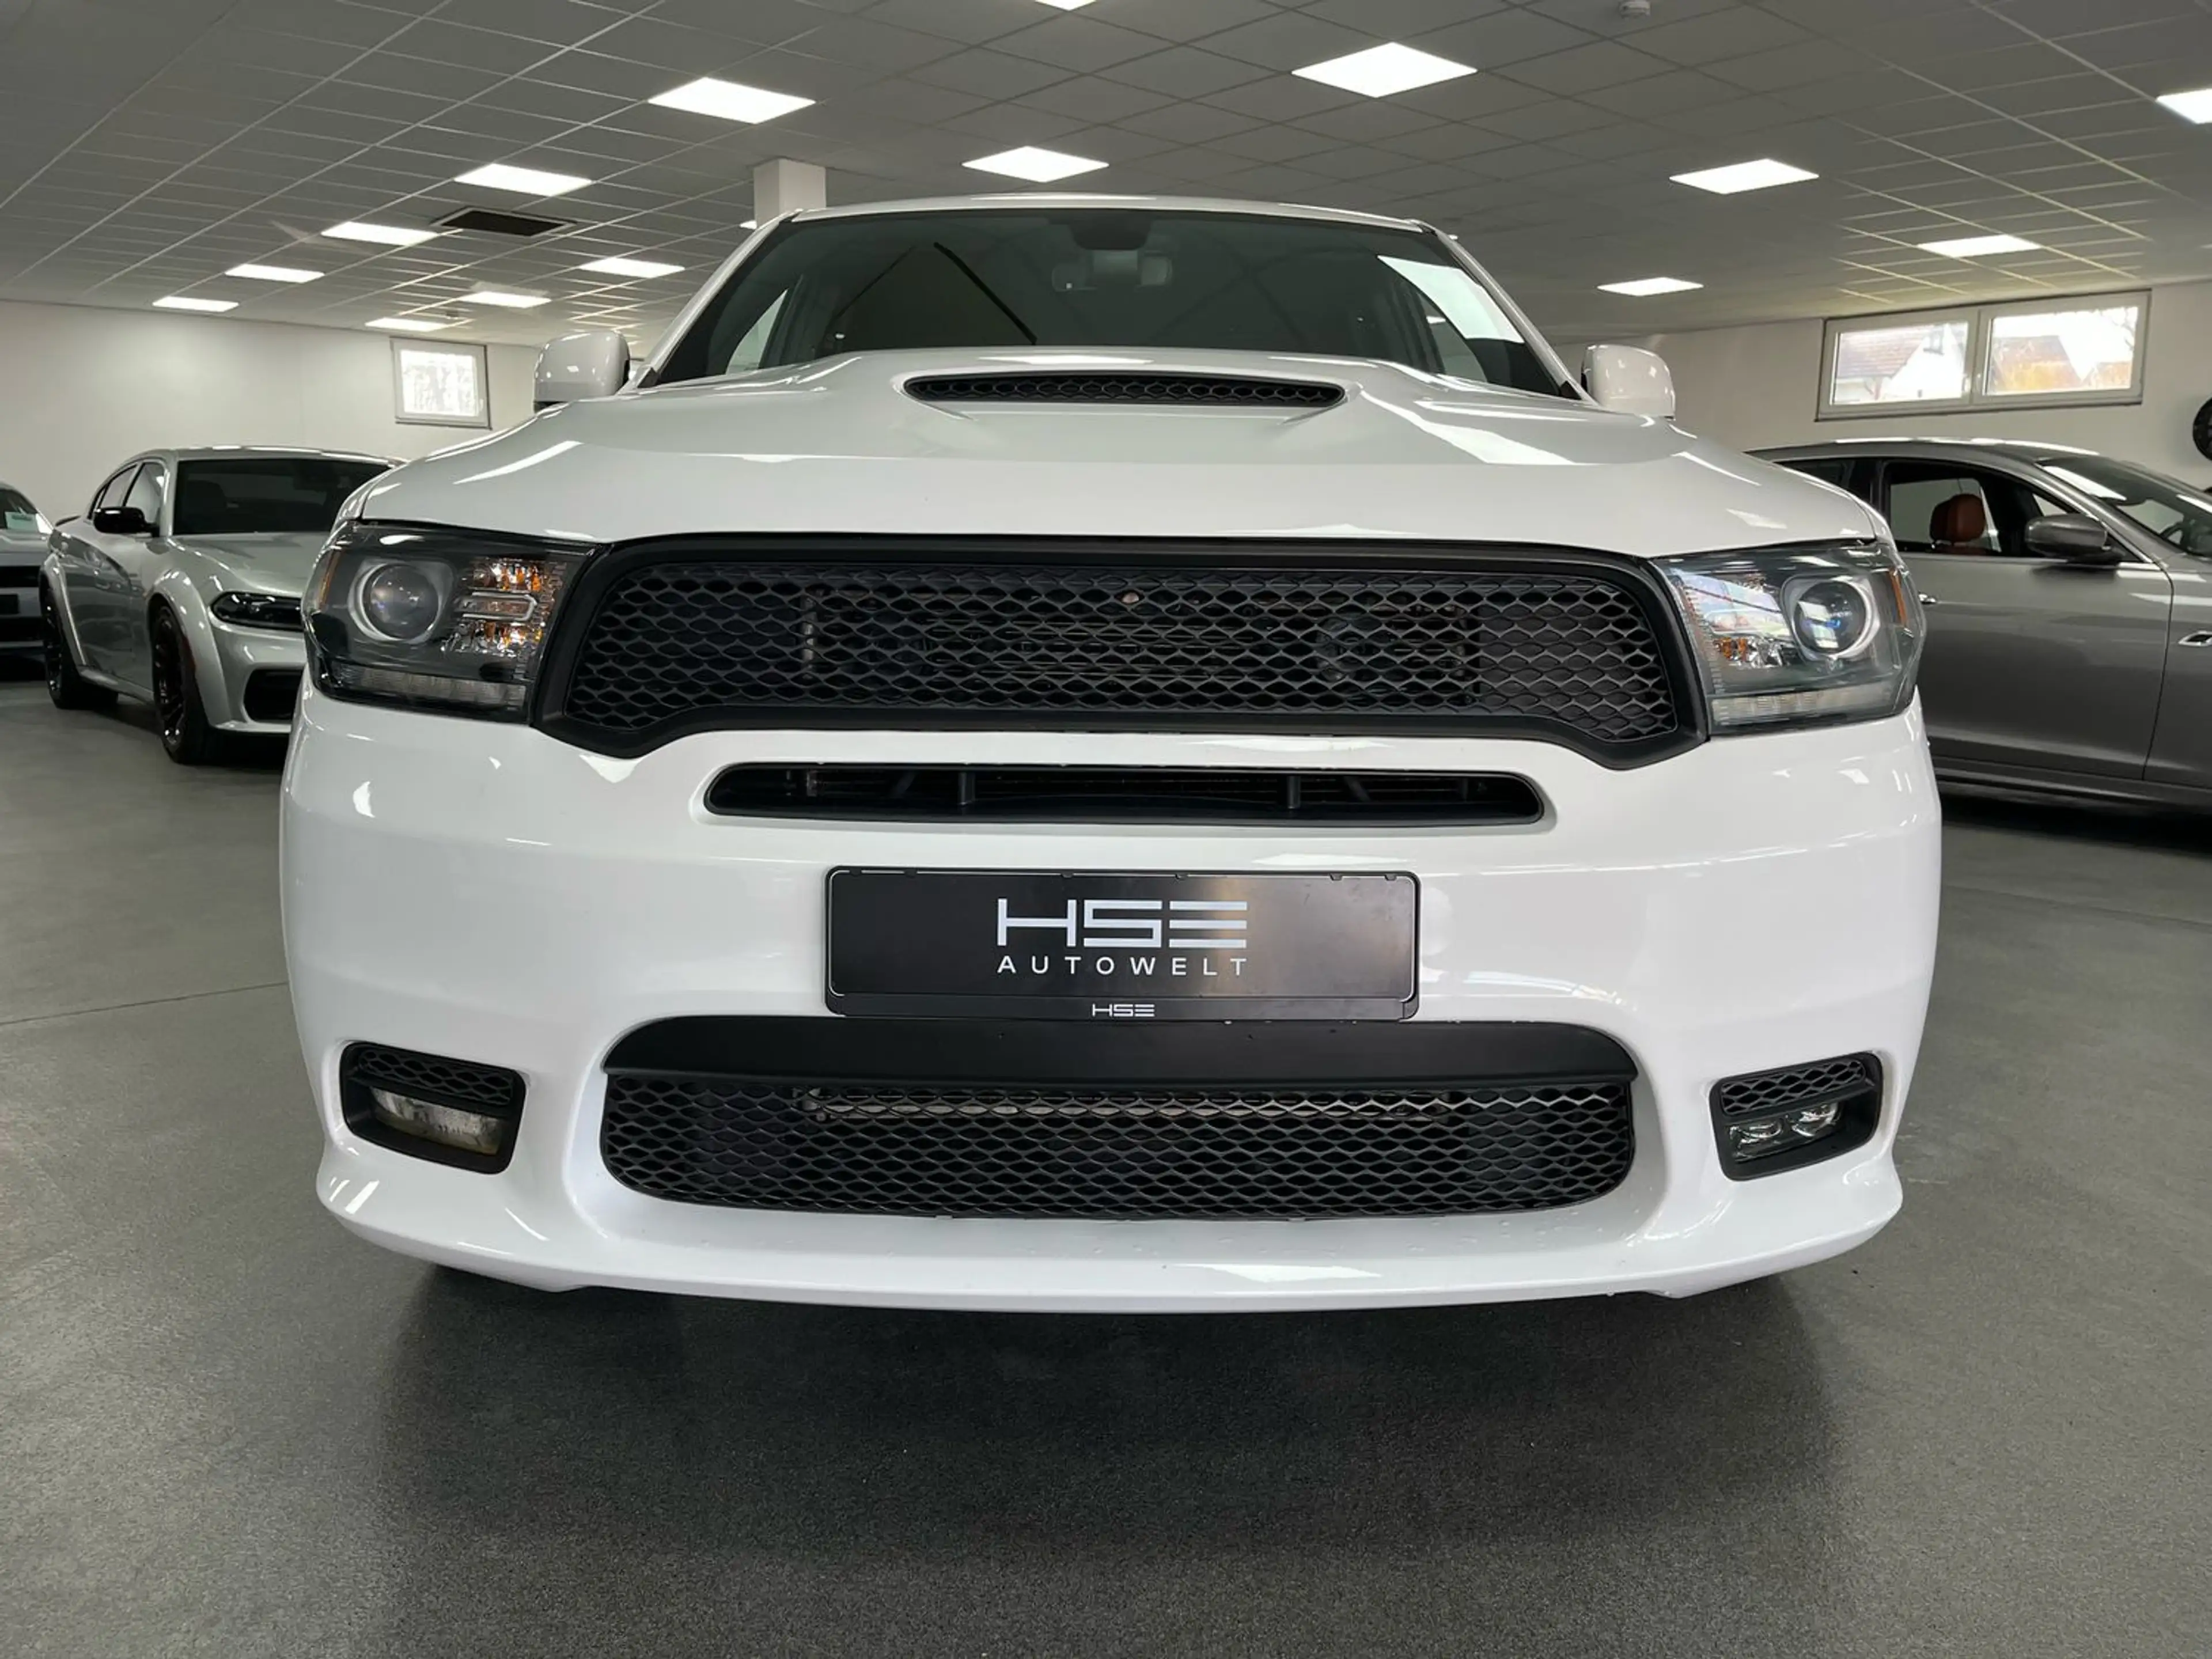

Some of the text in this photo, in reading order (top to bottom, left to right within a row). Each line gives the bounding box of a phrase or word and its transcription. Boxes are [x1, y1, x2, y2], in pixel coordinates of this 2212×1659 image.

[998, 899, 1247, 948] HSE
[998, 956, 1247, 975] AUTOWELT
[1092, 1003, 1155, 1017] HSE
